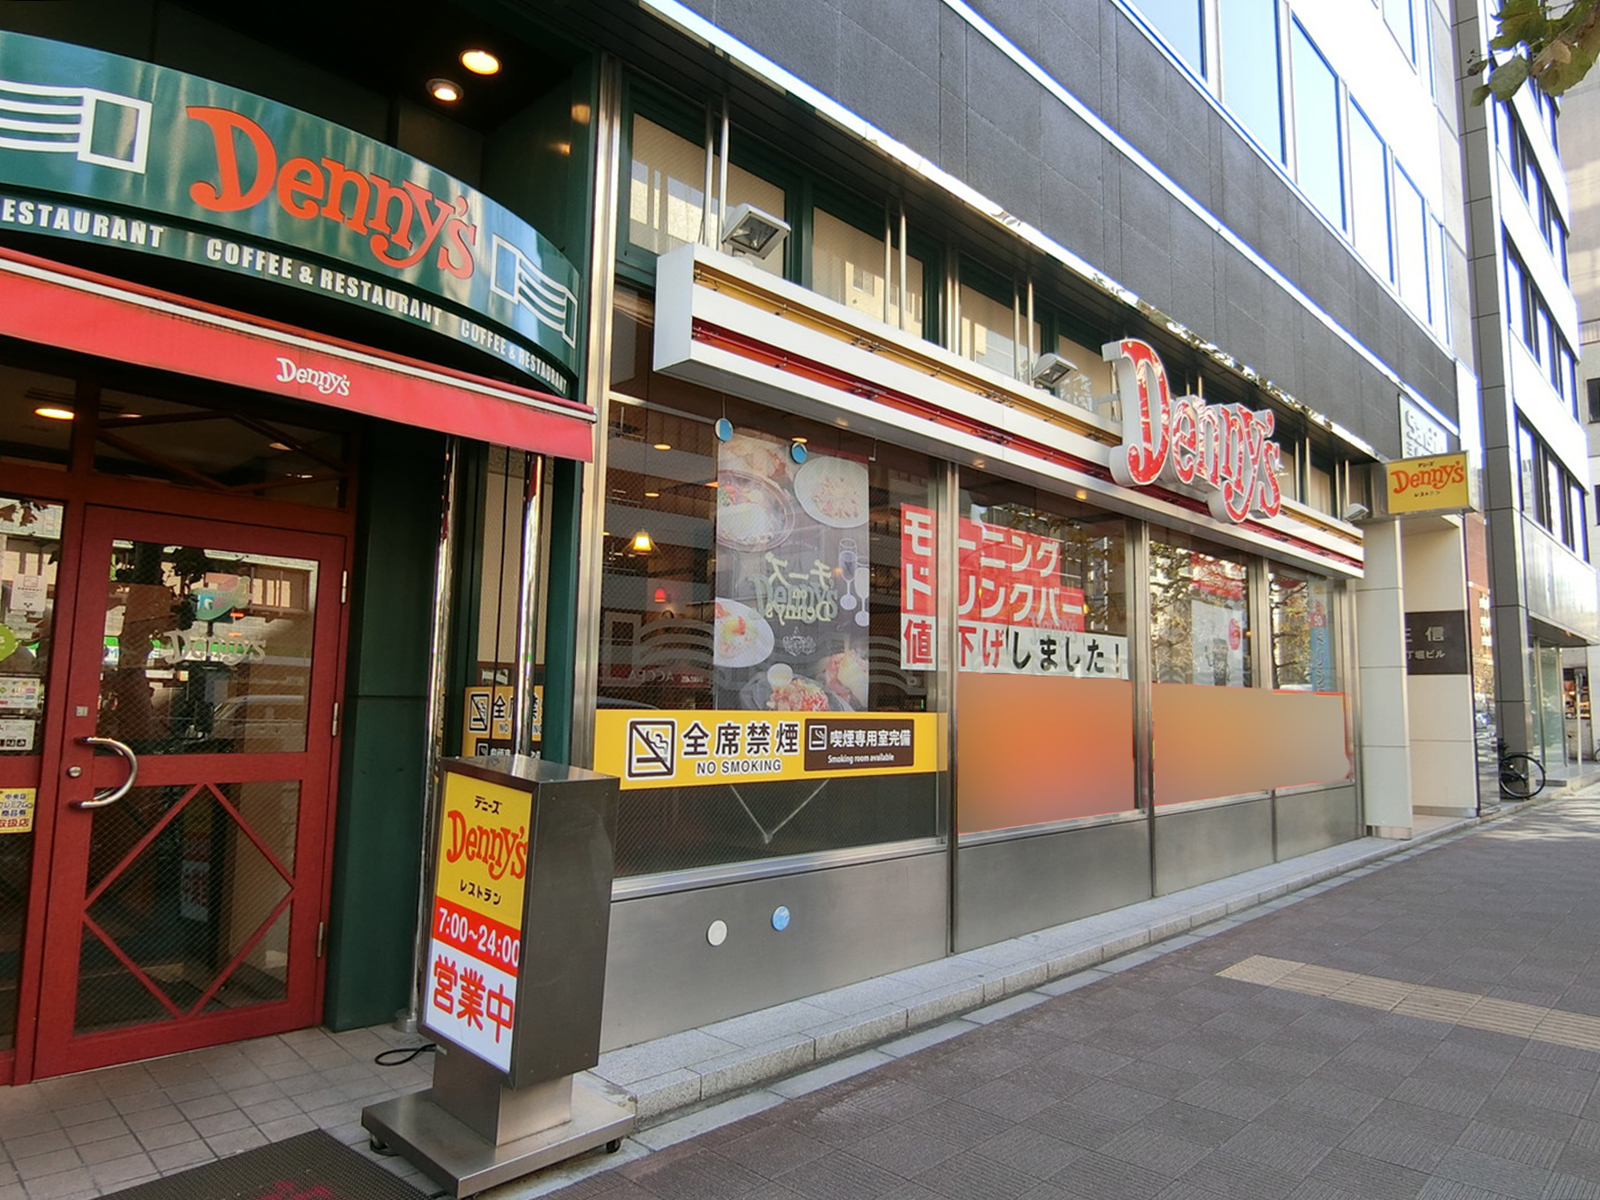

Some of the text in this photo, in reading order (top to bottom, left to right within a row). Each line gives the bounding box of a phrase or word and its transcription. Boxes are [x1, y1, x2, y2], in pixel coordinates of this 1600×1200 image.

[185, 105, 477, 280] Denny's
[2, 199, 164, 248] ESTAURANT
[206, 238, 442, 326] COFFEE & RESTAURANT
[461, 319, 567, 394] COFFEE & RESTAURANT
[276, 357, 351, 396] Denny's
[1101, 337, 1281, 523] Denny's
[1390, 461, 1465, 494] Denny's
[681, 720, 800, 757] 全席禁煙
[830, 729, 912, 748] 喫煙専用室完備
[696, 758, 782, 776] NO SMOKING
[827, 753, 895, 765] Smoking room available
[474, 795, 503, 815] デニーズ
[446, 809, 527, 880] Denny's
[459, 879, 501, 906] レストラン
[433, 954, 514, 1044] 営業中
